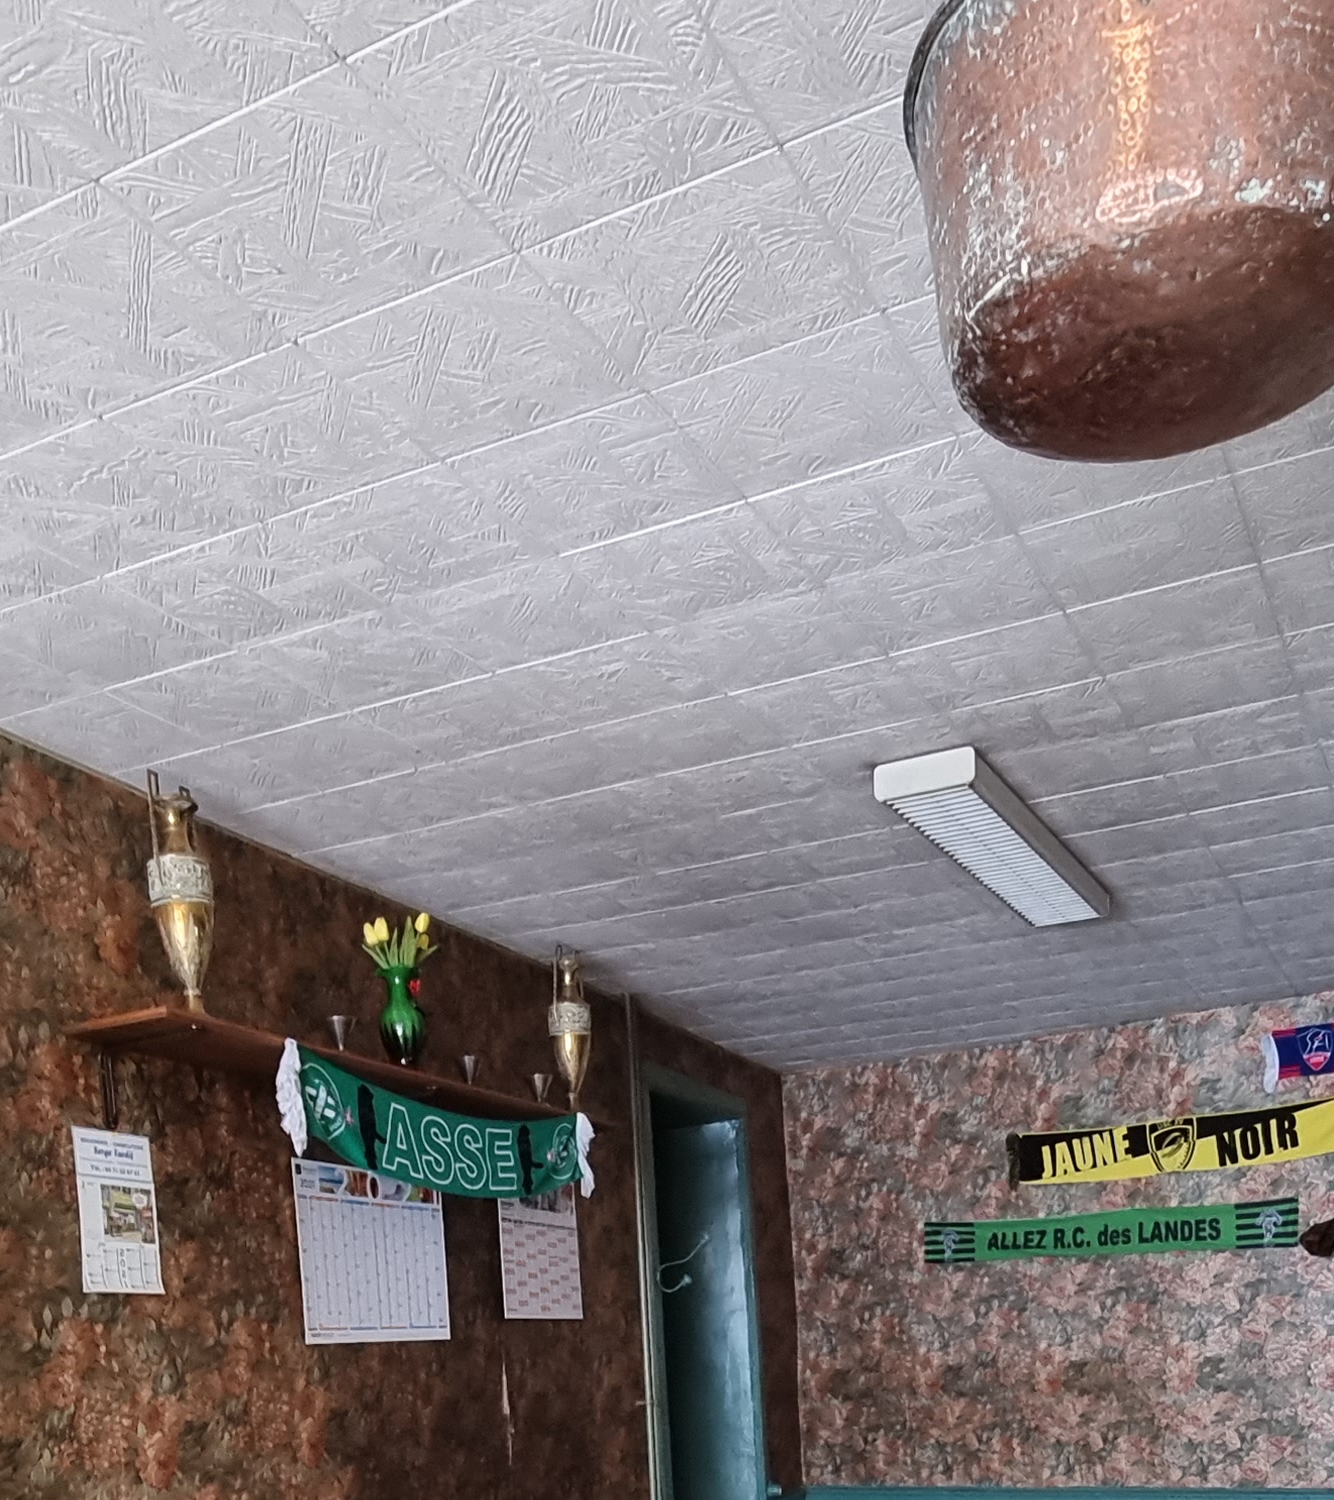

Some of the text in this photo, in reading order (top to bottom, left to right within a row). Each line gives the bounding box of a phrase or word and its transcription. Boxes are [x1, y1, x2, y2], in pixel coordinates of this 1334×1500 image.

[382, 1102, 517, 1191] ASSE
[1041, 1112, 1300, 1179] JAUNE NOIR
[986, 1218, 1222, 1252] ALLEZ R.C. des LANDES
